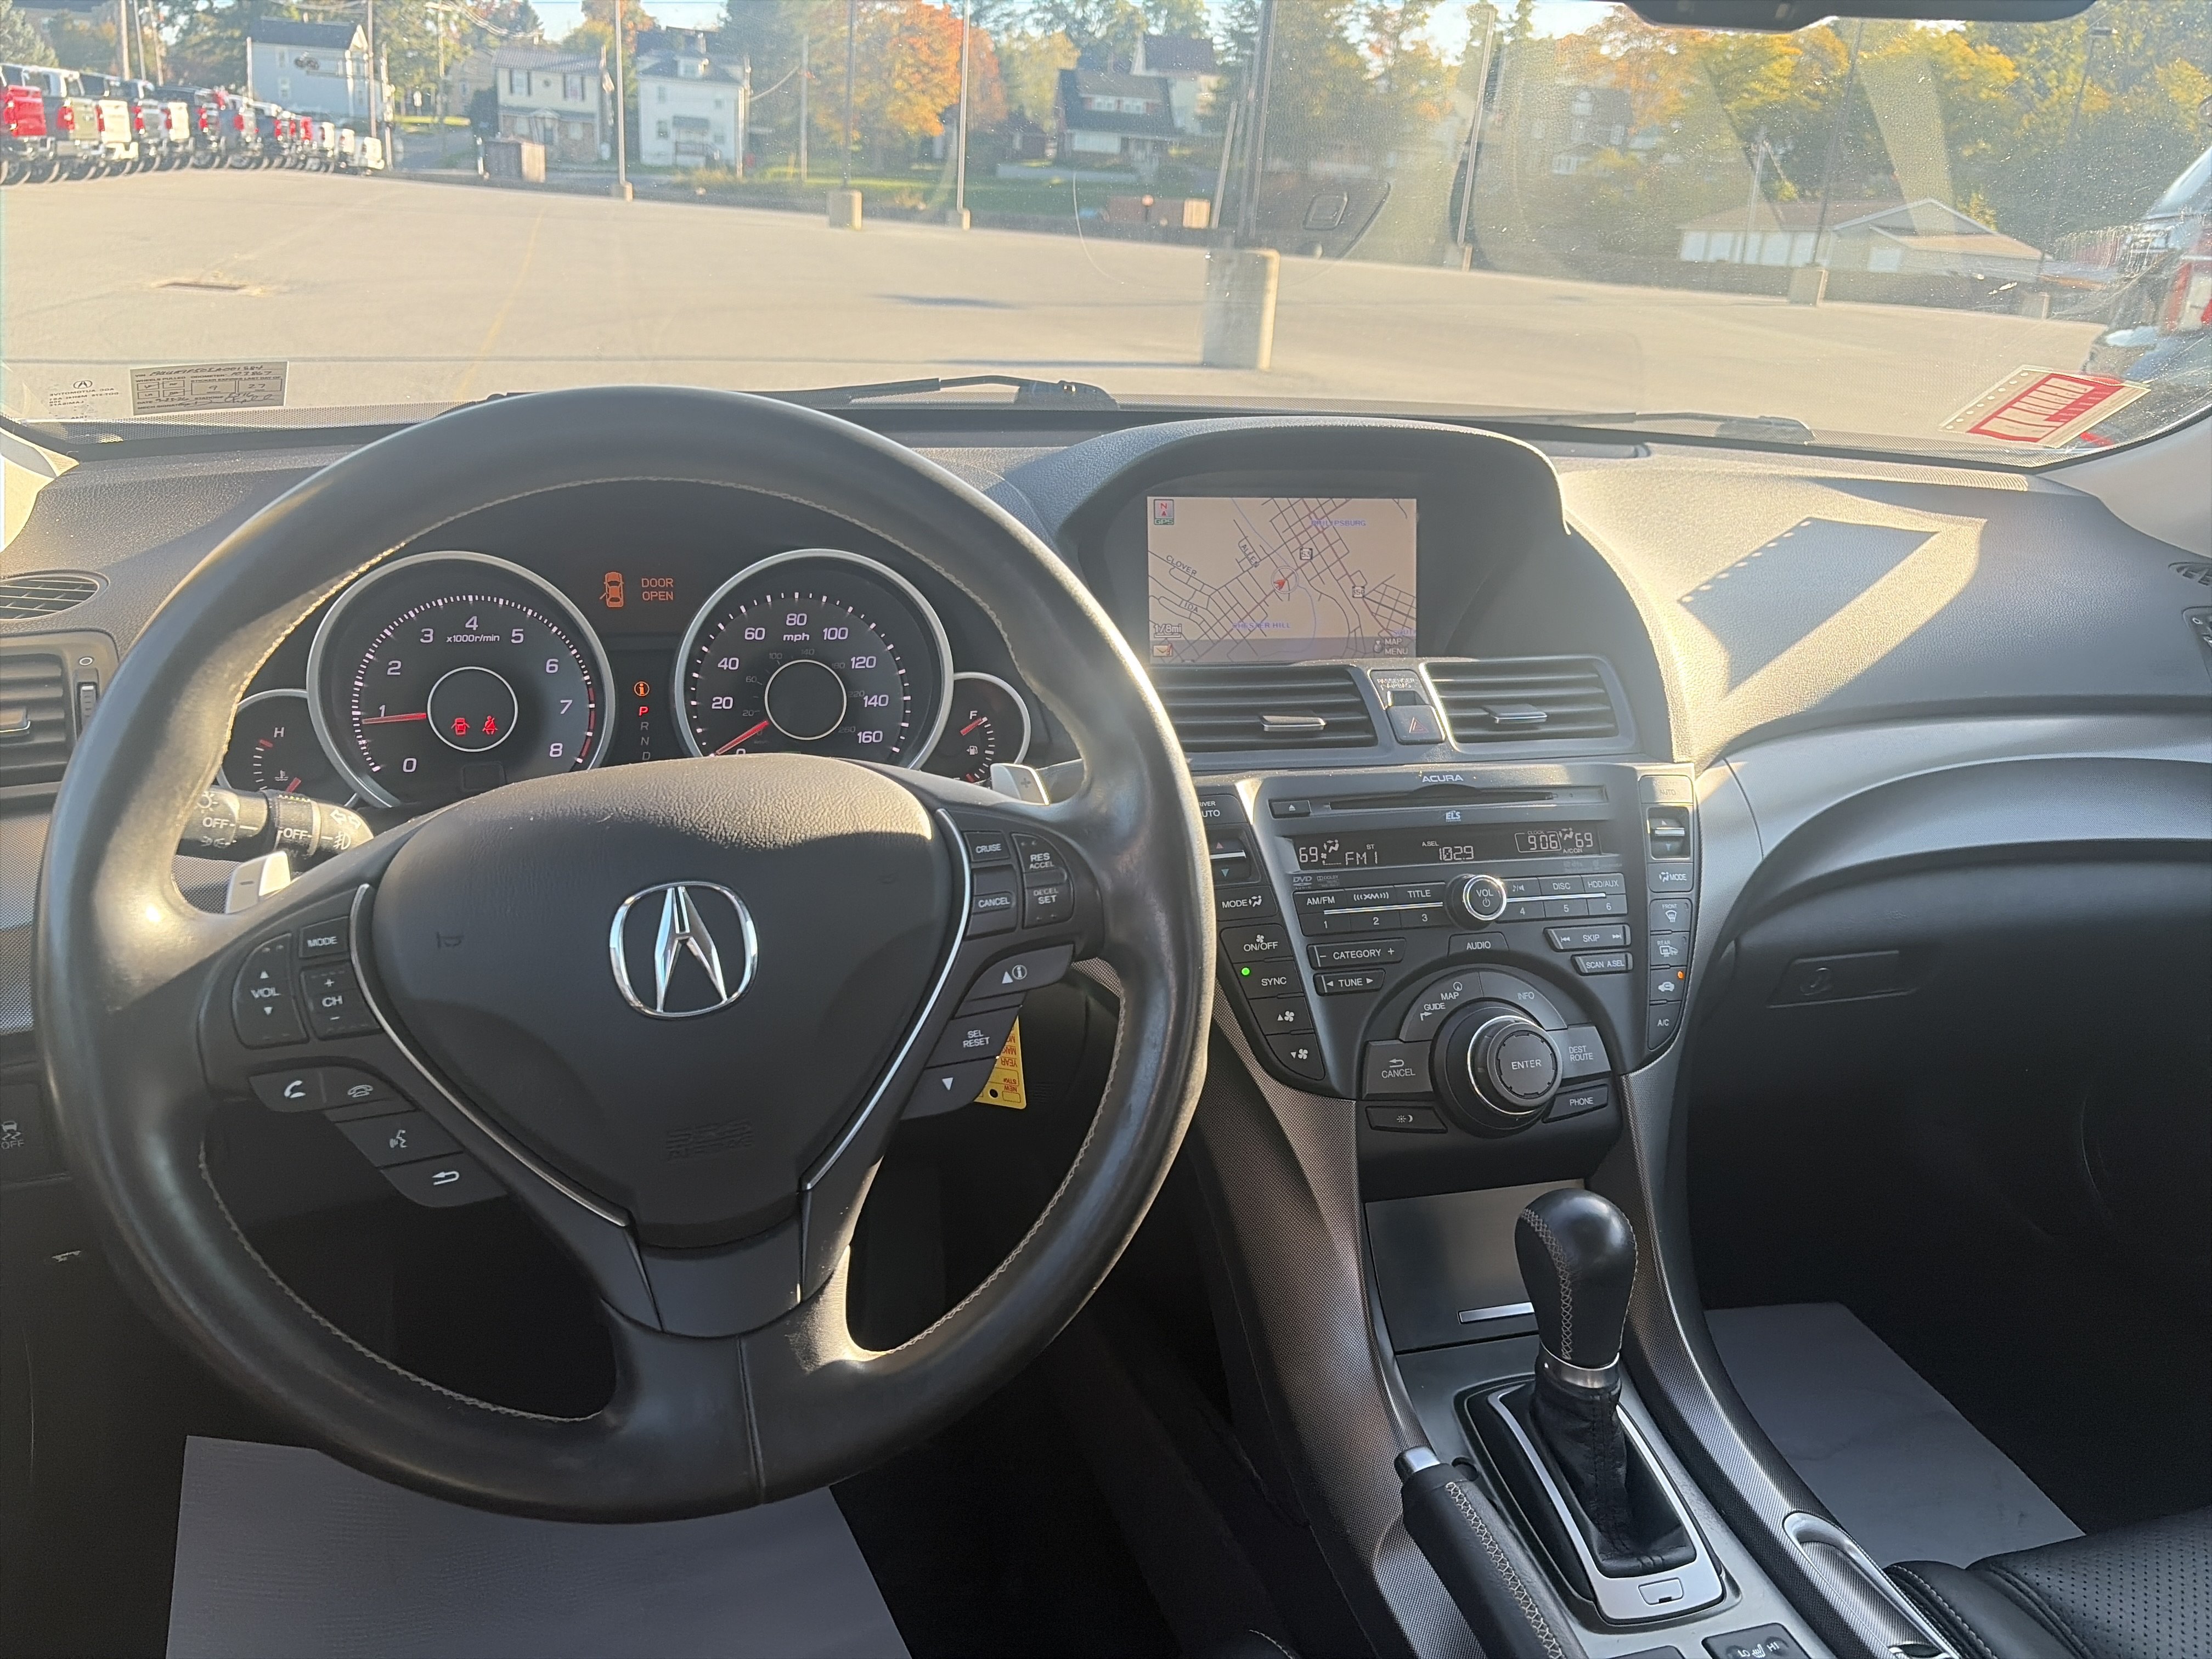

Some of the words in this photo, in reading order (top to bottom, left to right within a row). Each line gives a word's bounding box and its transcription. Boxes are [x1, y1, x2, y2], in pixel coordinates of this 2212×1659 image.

[1166, 555, 1197, 576] CLOVER
[641, 578, 674, 588] DOOR
[642, 591, 674, 601] OPEN
[1183, 602, 1198, 613] IDA
[465, 616, 479, 630] 4
[786, 613, 808, 627] 80
[1154, 623, 1182, 634] 1/8mi
[420, 628, 435, 644] 3
[445, 633, 500, 644] x1000r/min
[511, 629, 524, 644] 5
[744, 627, 766, 641] 60
[783, 632, 810, 642] mph
[822, 627, 849, 641] 100
[545, 658, 559, 673] 6
[717, 657, 740, 670] 40
[850, 656, 877, 669] 120
[386, 661, 402, 676] 2
[711, 696, 734, 710] 20
[863, 694, 889, 708] 140
[378, 704, 386, 718] 1
[559, 699, 573, 714] 7
[638, 706, 649, 716] P
[969, 710, 978, 720] F
[640, 721, 650, 731] R
[274, 727, 285, 738] H
[857, 731, 883, 744] 160
[640, 736, 650, 746] N
[549, 743, 564, 758] 8
[642, 751, 651, 760] D
[402, 758, 417, 772] 0
[1421, 774, 1464, 782] ACURA
[1201, 809, 1221, 818] UTO
[1445, 811, 1461, 820] ELS
[202, 817, 230, 829] OFF
[283, 827, 308, 840] OFF
[1575, 832, 1593, 848] 69
[975, 843, 1002, 854] CRUISE
[1030, 853, 1050, 862] RES
[1299, 847, 1318, 863] 69
[1029, 861, 1054, 869] ACCEL
[1552, 882, 1571, 890] DISC
[1587, 880, 1620, 888] HDD/AUX
[1407, 889, 1431, 898] TITLE
[1476, 888, 1494, 897] VOL
[978, 897, 1011, 908] CANCEL
[1038, 895, 1057, 905] SET
[1222, 899, 1248, 909] MODE
[1306, 896, 1335, 905] AM/FM
[1519, 907, 1526, 915] 4
[1563, 904, 1569, 912] 5
[1606, 902, 1612, 911] 6
[1373, 917, 1380, 926] 2
[1421, 913, 1428, 922] 3
[1323, 921, 1328, 929] 1
[307, 935, 338, 948] MODE
[1582, 934, 1600, 943] SKIP
[1243, 941, 1278, 952] ON/OFF
[1466, 941, 1492, 950] AUDIO
[1333, 949, 1382, 960] CATEGORY
[1585, 961, 1604, 969] SCAN
[1261, 976, 1287, 986] SYNC
[1338, 978, 1363, 987] TUNE
[250, 986, 281, 1000] VOL
[1440, 991, 1460, 1001] MAP
[1517, 991, 1535, 1001] INFO
[321, 995, 343, 1008] CH
[1424, 1002, 1446, 1012] GUIDE
[1657, 1018, 1669, 1028] A/C
[967, 1029, 984, 1039] SEL
[962, 1036, 991, 1048] RESET
[1570, 1052, 1594, 1063] ROUTE
[1000, 1058, 1018, 1068] YEAR
[1511, 1059, 1542, 1070] ENTER
[1381, 1068, 1416, 1079] CANCEL
[1003, 1085, 1018, 1093] NEW
[1569, 1097, 1594, 1107] PHONE
[1, 1139, 25, 1150] OFF
[1767, 1641, 1780, 1652] HI
[1737, 1649, 1751, 1657] LO
